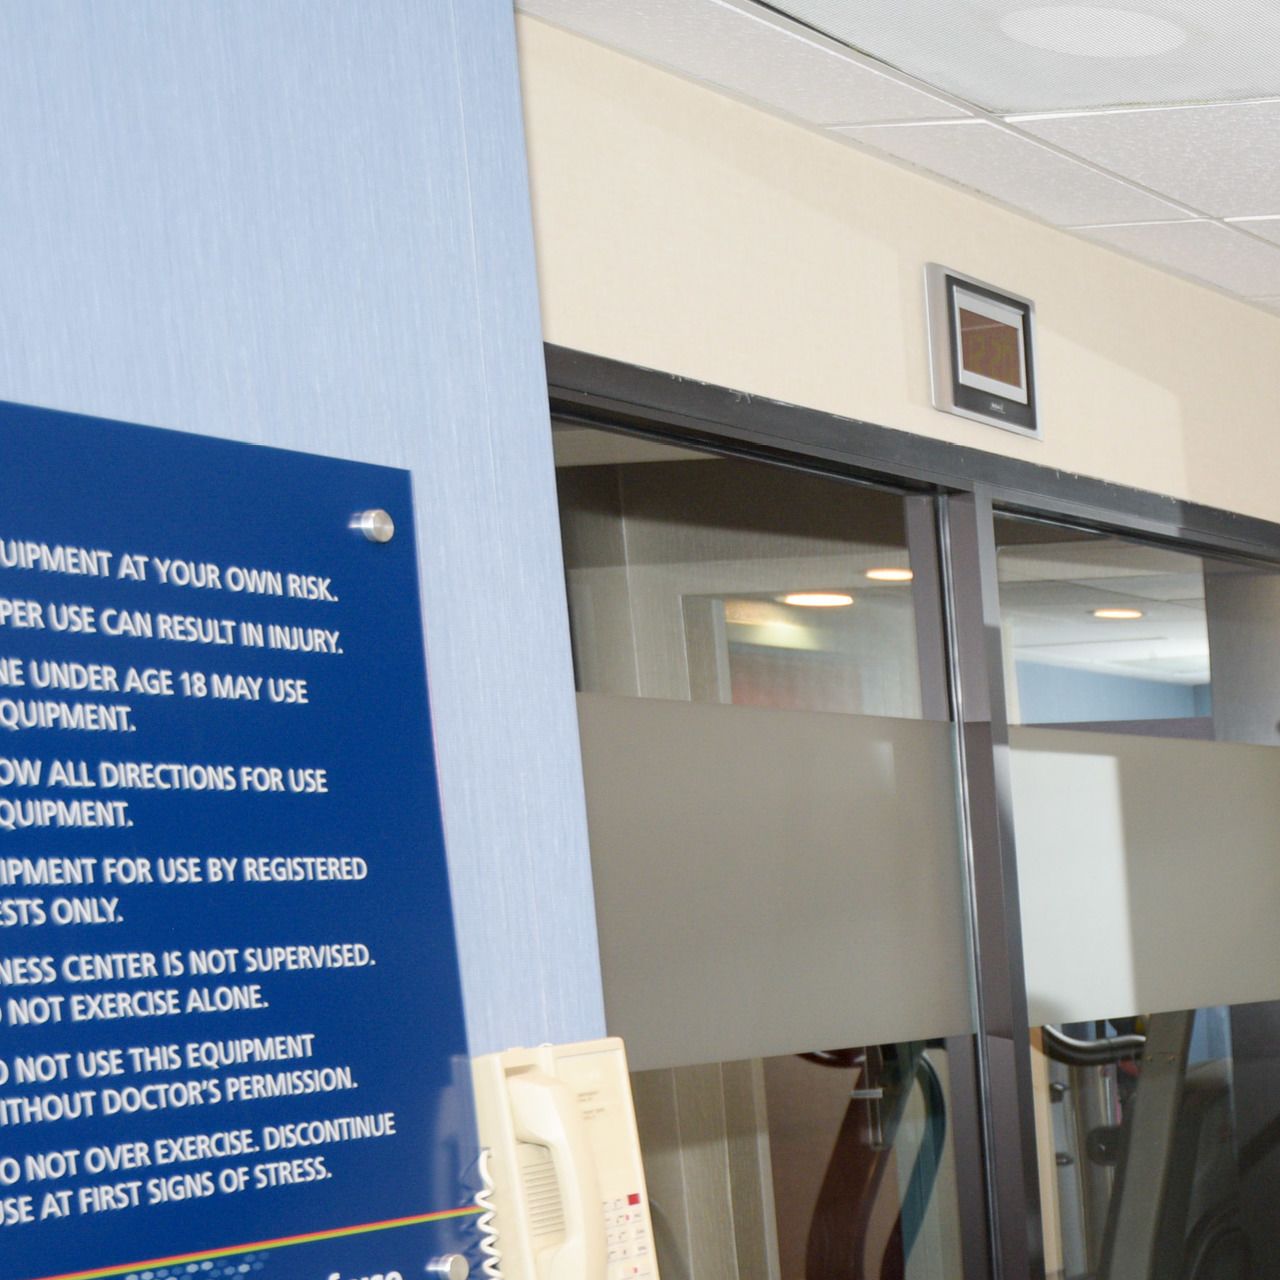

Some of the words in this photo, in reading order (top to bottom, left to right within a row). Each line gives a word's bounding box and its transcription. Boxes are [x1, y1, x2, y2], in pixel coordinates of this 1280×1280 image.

[117, 554, 149, 580] AT
[152, 556, 222, 590] YOUR
[225, 566, 283, 596] OWN
[287, 573, 339, 602] RISK.
[0, 597, 45, 629] PER
[48, 603, 97, 634] USE
[100, 608, 153, 638] CAN
[157, 614, 236, 645] RESULT
[239, 621, 265, 648] IN
[268, 624, 344, 654] INJURY.
[29, 659, 119, 693] UNDER
[123, 667, 174, 695] AGE
[179, 671, 208, 698] 18
[211, 673, 263, 701] MAY
[268, 677, 309, 704] USE
[48, 760, 96, 787] ALL
[100, 761, 237, 791] DIRECTIONS
[240, 766, 285, 792] FOR
[288, 768, 328, 793] USE
[103, 857, 153, 884] FOR
[157, 857, 203, 883] USE
[207, 857, 237, 883] BY
[243, 856, 368, 882] REGISTERED
[0, 897, 46, 926] STS
[51, 896, 124, 924] ONLY.
[62, 952, 158, 982] CENTER
[162, 951, 184, 977] IS
[189, 949, 239, 976] NOT
[244, 943, 376, 974] SUPERVISED.
[7, 996, 64, 1026] NOT
[70, 989, 181, 1022] EXERCISE
[185, 984, 269, 1014] ALONE.
[14, 1053, 71, 1084] NOT
[77, 1049, 125, 1078] USE
[128, 1044, 182, 1073] THIS
[186, 1033, 315, 1069] EQUIPMENT
[102, 1078, 222, 1116] DOCTOR'S
[226, 1065, 359, 1101] PERMISSION.
[25, 1149, 80, 1182] NOT
[84, 1141, 151, 1174] OVER
[154, 1129, 260, 1165] EXERCISE.
[263, 1112, 396, 1151] DISCONTINUE
[0, 1195, 35, 1226] SE
[40, 1189, 73, 1221] AT
[78, 1181, 142, 1215] FIRST
[146, 1171, 215, 1205] SIGNS
[219, 1166, 250, 1193] OF
[253, 1156, 332, 1189] STRESS.
